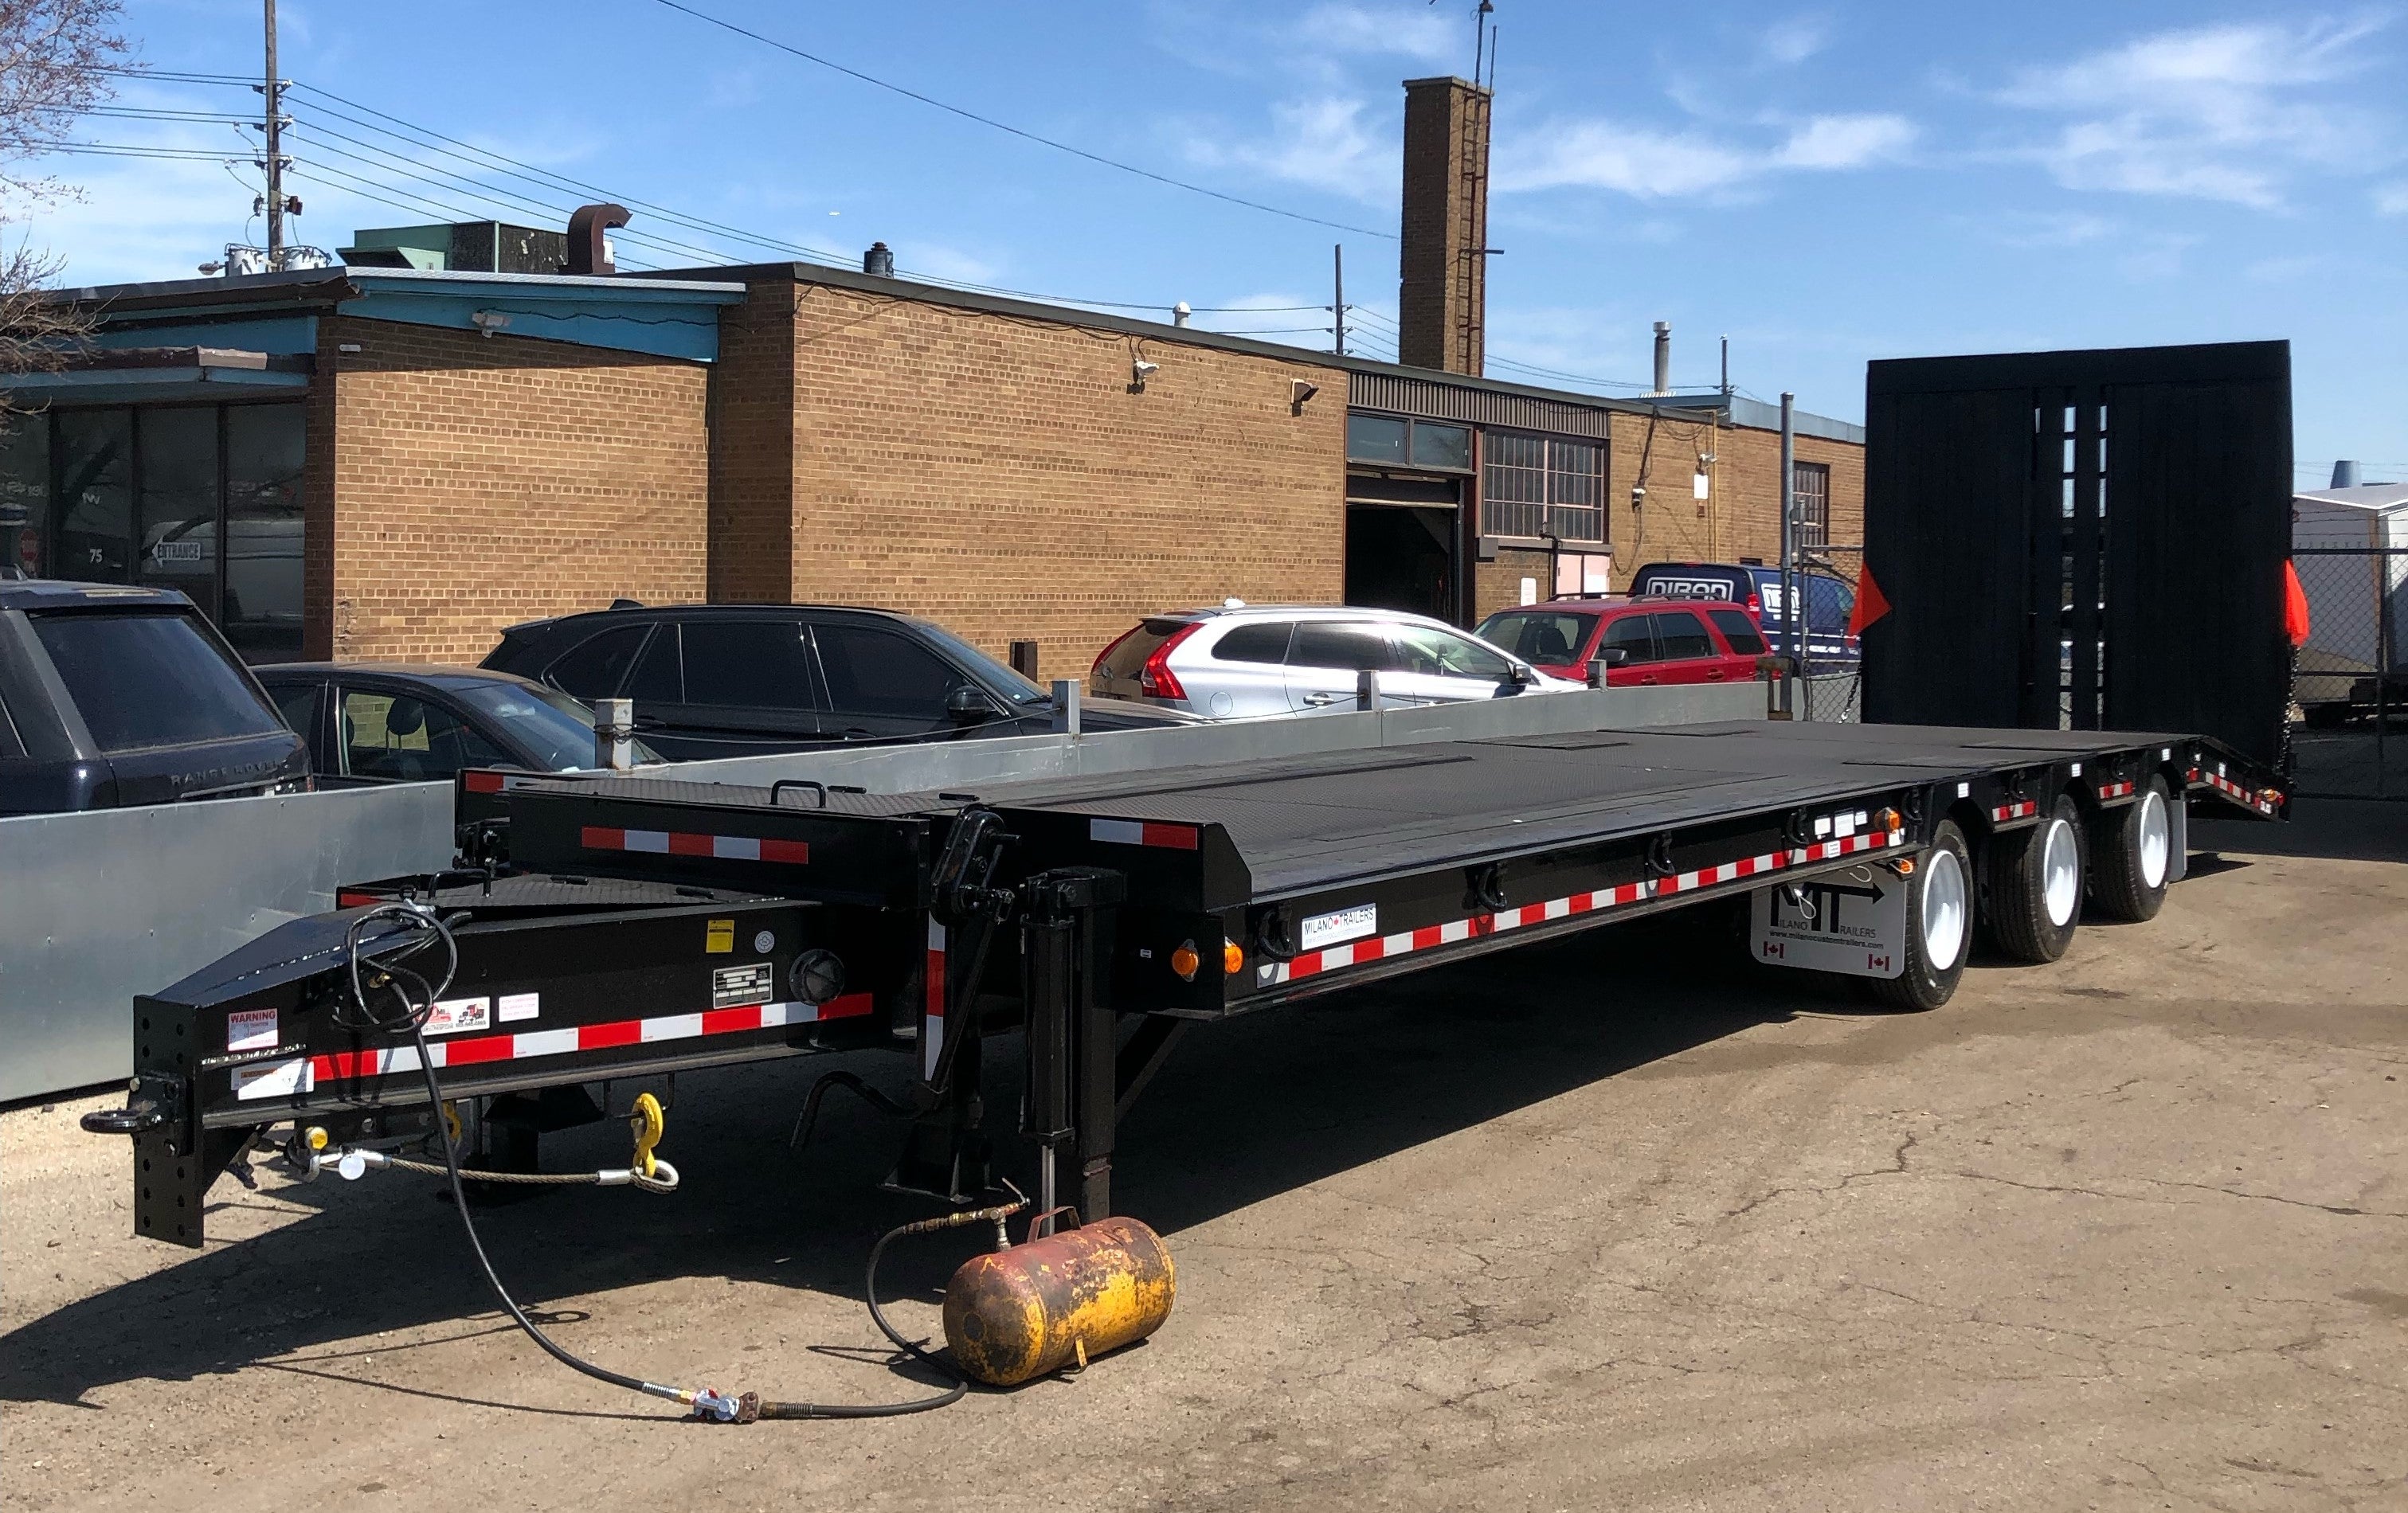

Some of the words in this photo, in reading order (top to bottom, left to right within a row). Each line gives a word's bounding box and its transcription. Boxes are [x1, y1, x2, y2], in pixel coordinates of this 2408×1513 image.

[90, 549, 103, 563] 75
[158, 544, 199, 558] ENTRANCE
[1305, 917, 1333, 935] MILANO
[1339, 908, 1374, 928] TRAILERS
[230, 1011, 276, 1023] WARNING
